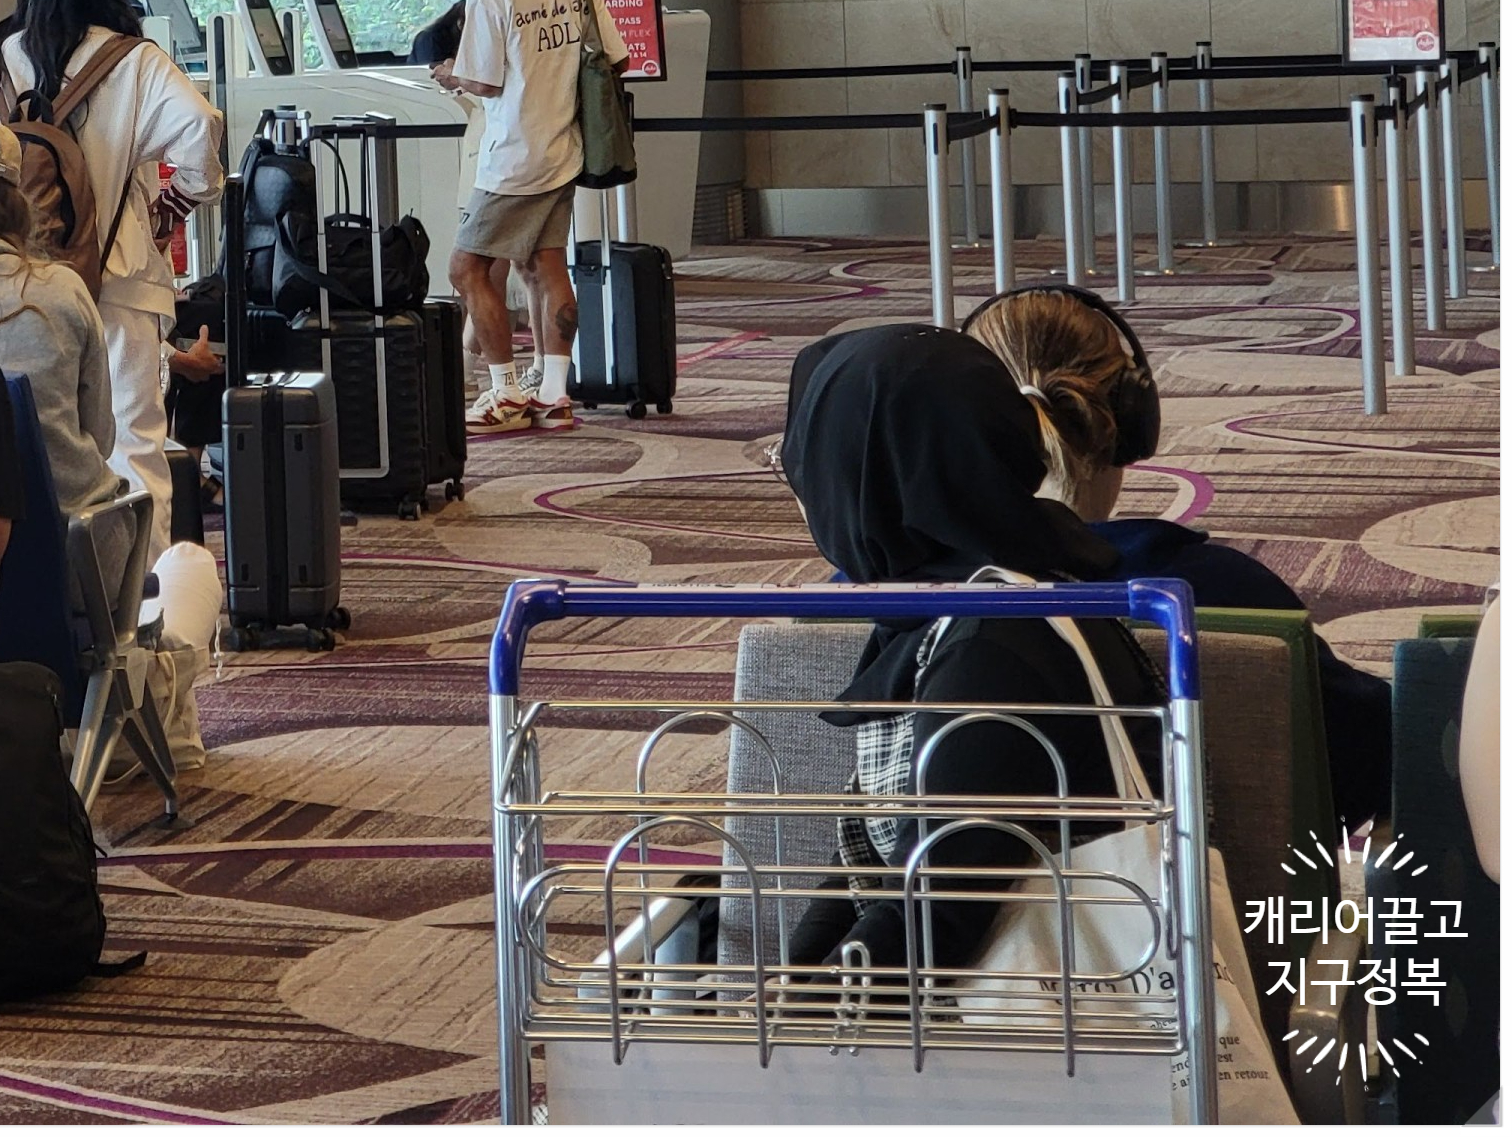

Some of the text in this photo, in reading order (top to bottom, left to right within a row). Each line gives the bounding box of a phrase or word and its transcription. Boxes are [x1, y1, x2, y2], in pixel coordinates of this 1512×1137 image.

[604, 0, 644, 9] ARDING
[619, 17, 641, 25] PASS
[629, 30, 651, 38] FLEX
[1219, 1036, 1240, 1049] que
